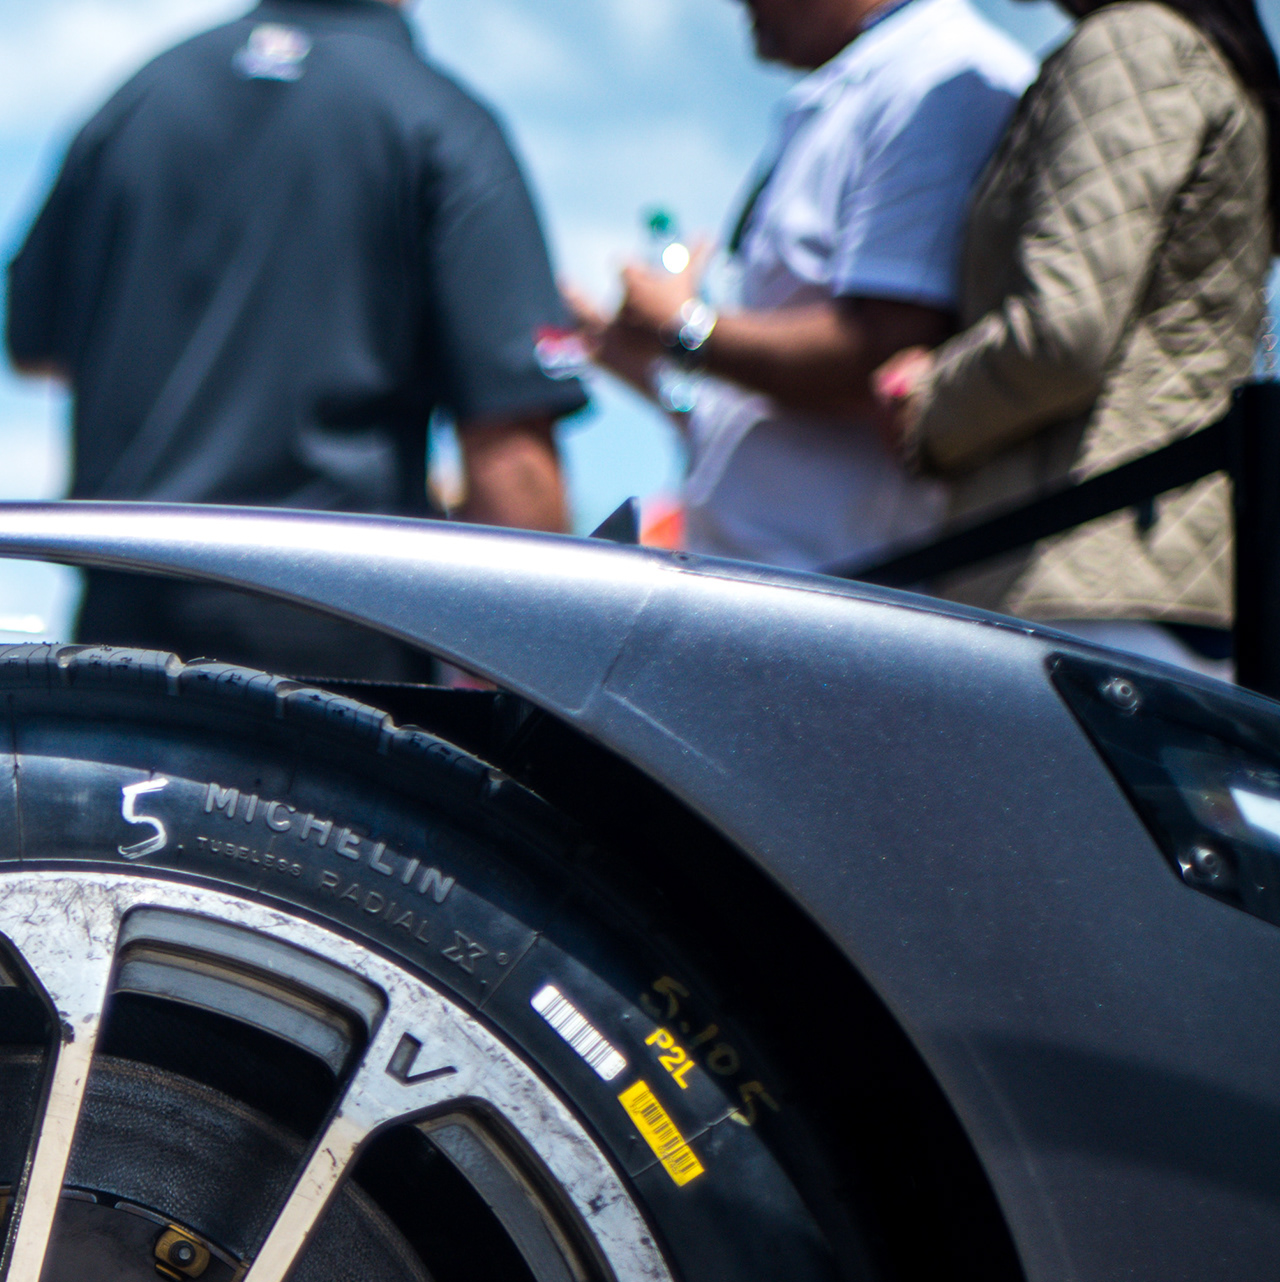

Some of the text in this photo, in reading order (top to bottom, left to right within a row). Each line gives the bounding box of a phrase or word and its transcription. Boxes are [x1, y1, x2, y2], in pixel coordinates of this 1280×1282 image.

[118, 777, 169, 860] 5
[203, 781, 455, 904] MICHELIN
[196, 836, 303, 877] TUBELESS
[319, 870, 430, 945] RADIAL
[644, 1026, 696, 1091] P2L
